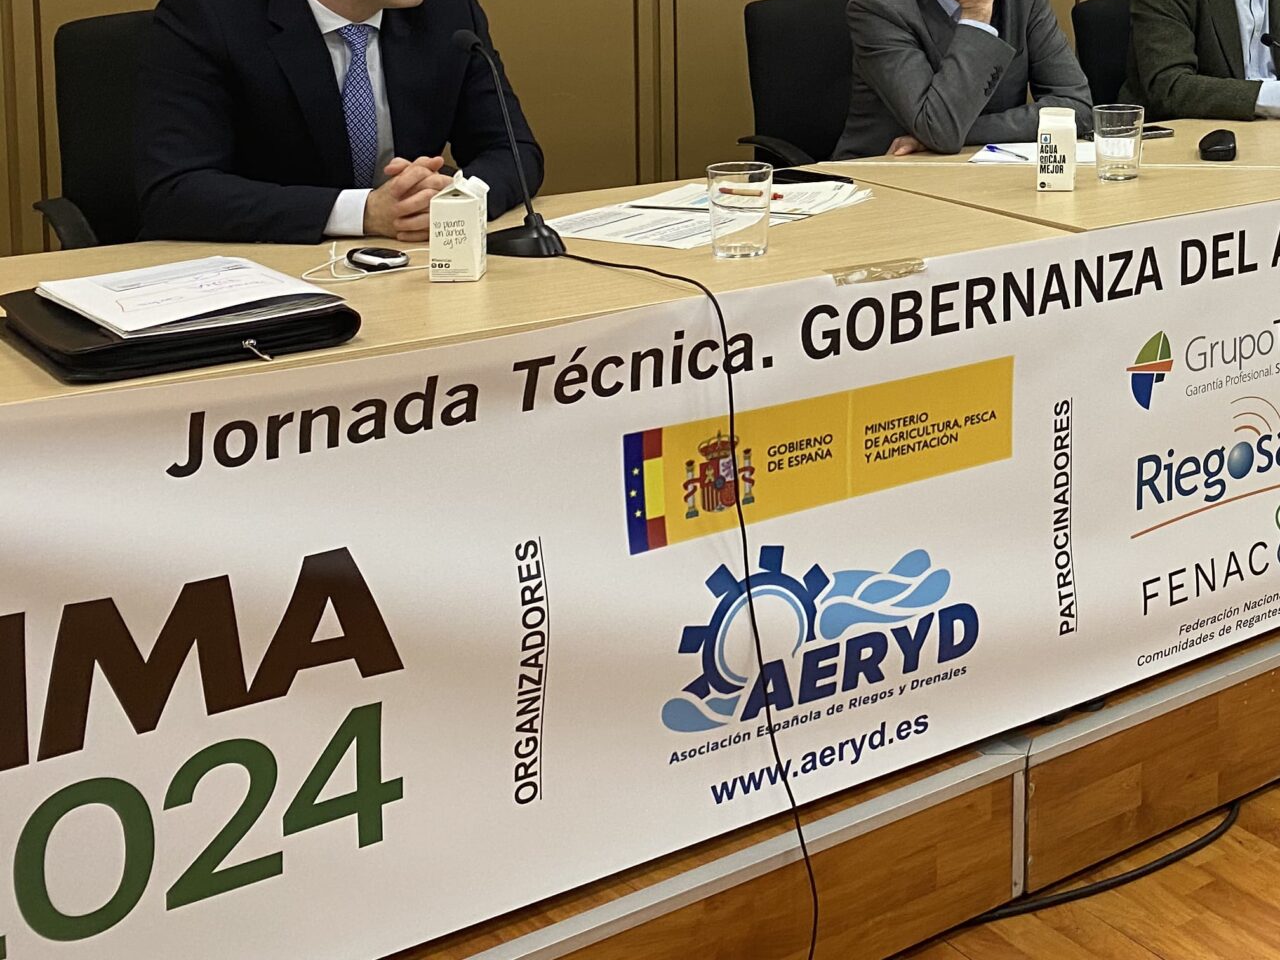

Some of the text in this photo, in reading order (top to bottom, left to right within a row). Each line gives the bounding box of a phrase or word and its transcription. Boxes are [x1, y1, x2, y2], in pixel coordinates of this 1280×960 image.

[1040, 144, 1058, 154] AGUA
[1040, 164, 1064, 174] MEJOR
[166, 375, 480, 478] Jornada
[512, 330, 773, 412] Técnica.
[801, 246, 1164, 360] GOBERNANZA
[1179, 231, 1259, 288] DEL
[1185, 378, 1224, 397] Garantía
[1226, 365, 1274, 387] Profesional.
[864, 410, 997, 450] DE AGRICULTURA, PESCA
[865, 412, 928, 435] MINISTERIO
[768, 433, 834, 458] GOBIERNO
[768, 448, 834, 472] DE ESPAÑA
[864, 432, 959, 464] Y ALIMENTACIÓN
[1053, 398, 1076, 636] PATROCINADORES
[1179, 606, 1240, 636] Federación
[0, 547, 404, 771] IMA
[740, 602, 980, 722] AERYD
[1137, 632, 1214, 667] Comunidades
[1218, 624, 1232, 638] de
[514, 538, 545, 805] ORGANIZADORES
[669, 665, 968, 765] Asociación Española de Riegos y Drenajes
[710, 714, 929, 805] www.aeryd.es
[0, 701, 404, 959] 024
